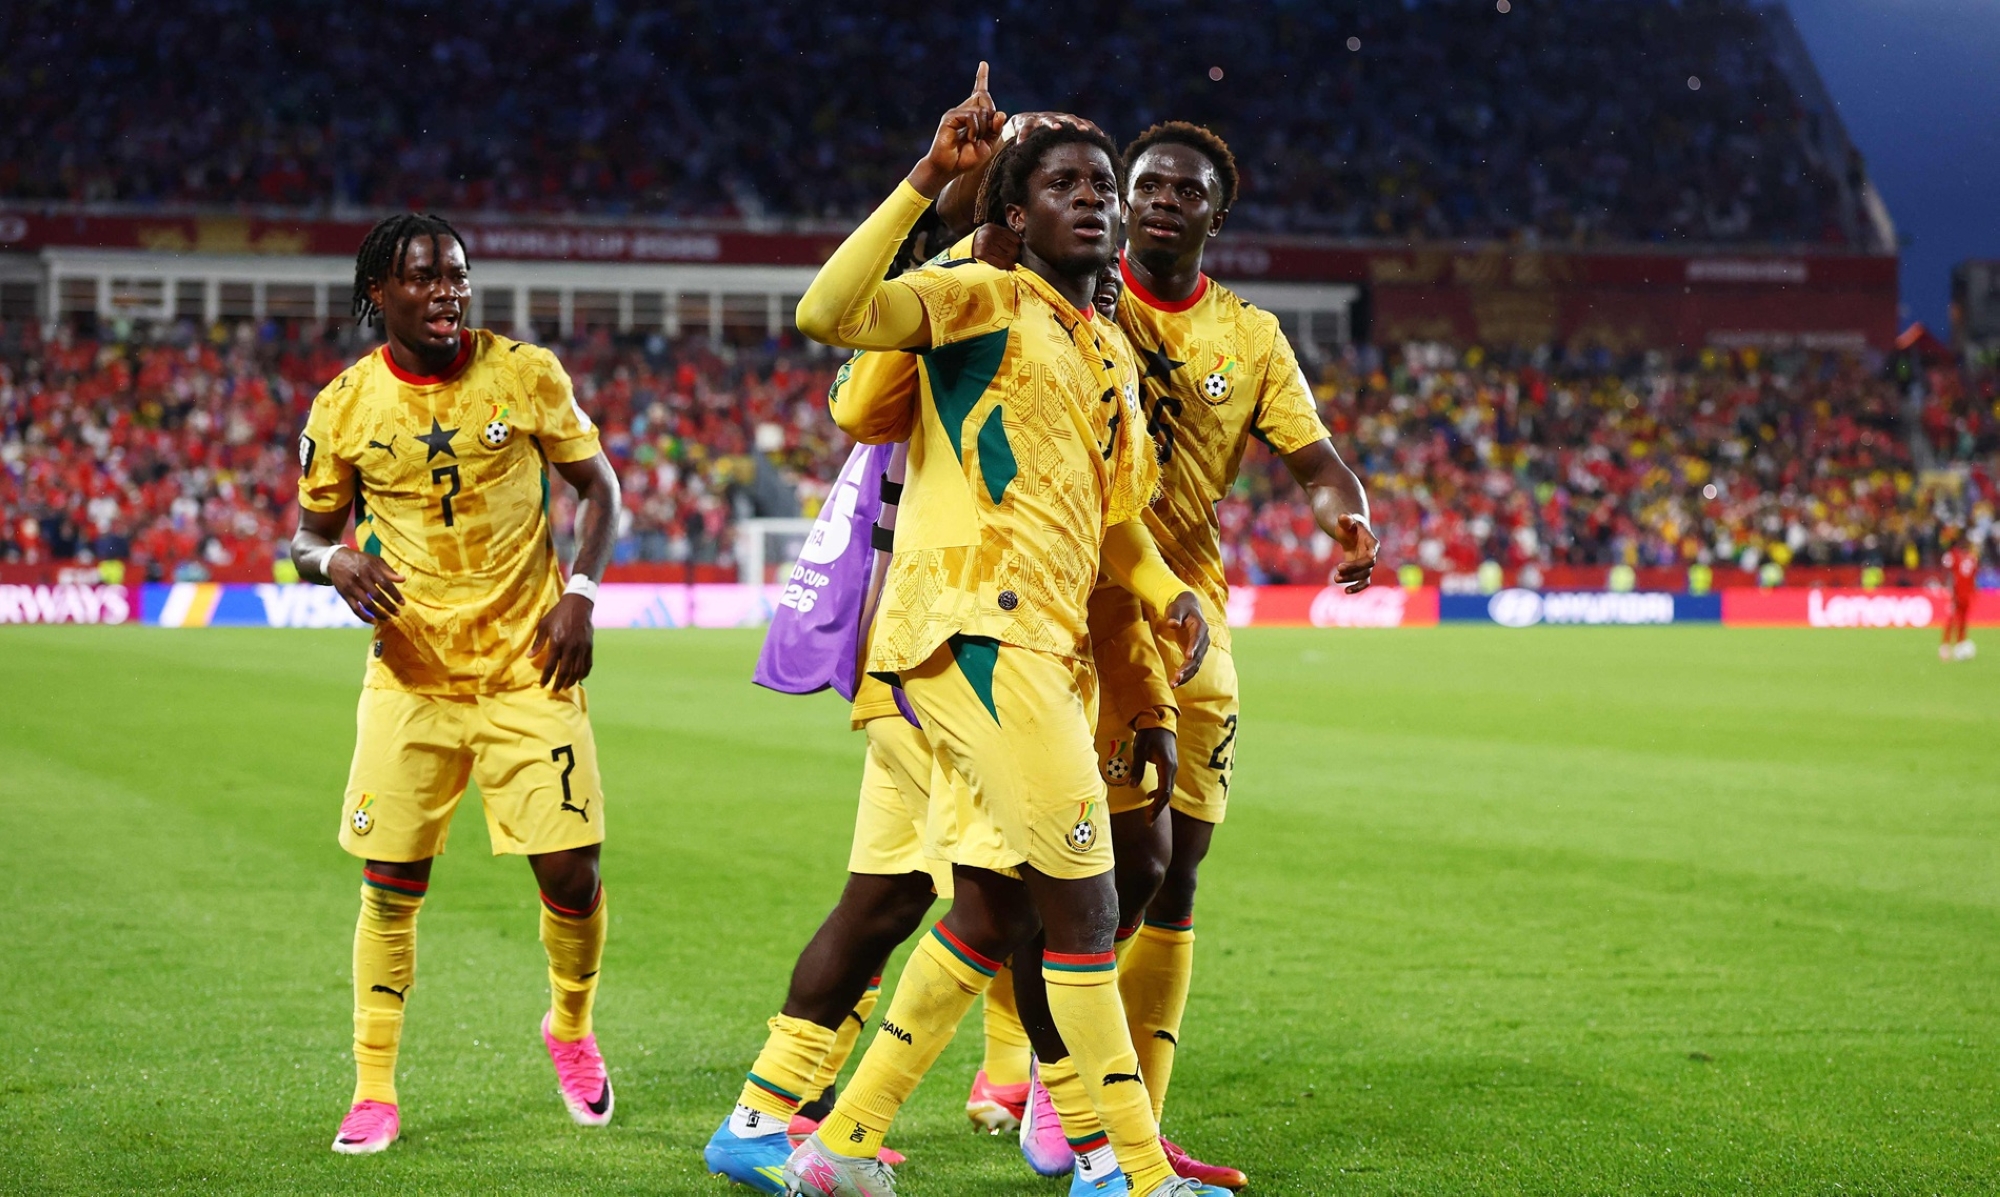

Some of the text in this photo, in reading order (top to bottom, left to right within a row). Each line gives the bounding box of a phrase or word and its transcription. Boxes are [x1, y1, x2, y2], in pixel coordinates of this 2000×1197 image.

[432, 465, 460, 527] 7
[803, 568, 830, 588] CUP
[780, 583, 818, 613] 26
[1544, 591, 1675, 624] HYUNDAI
[1807, 588, 1934, 627] Lenovo
[551, 744, 575, 801] 7
